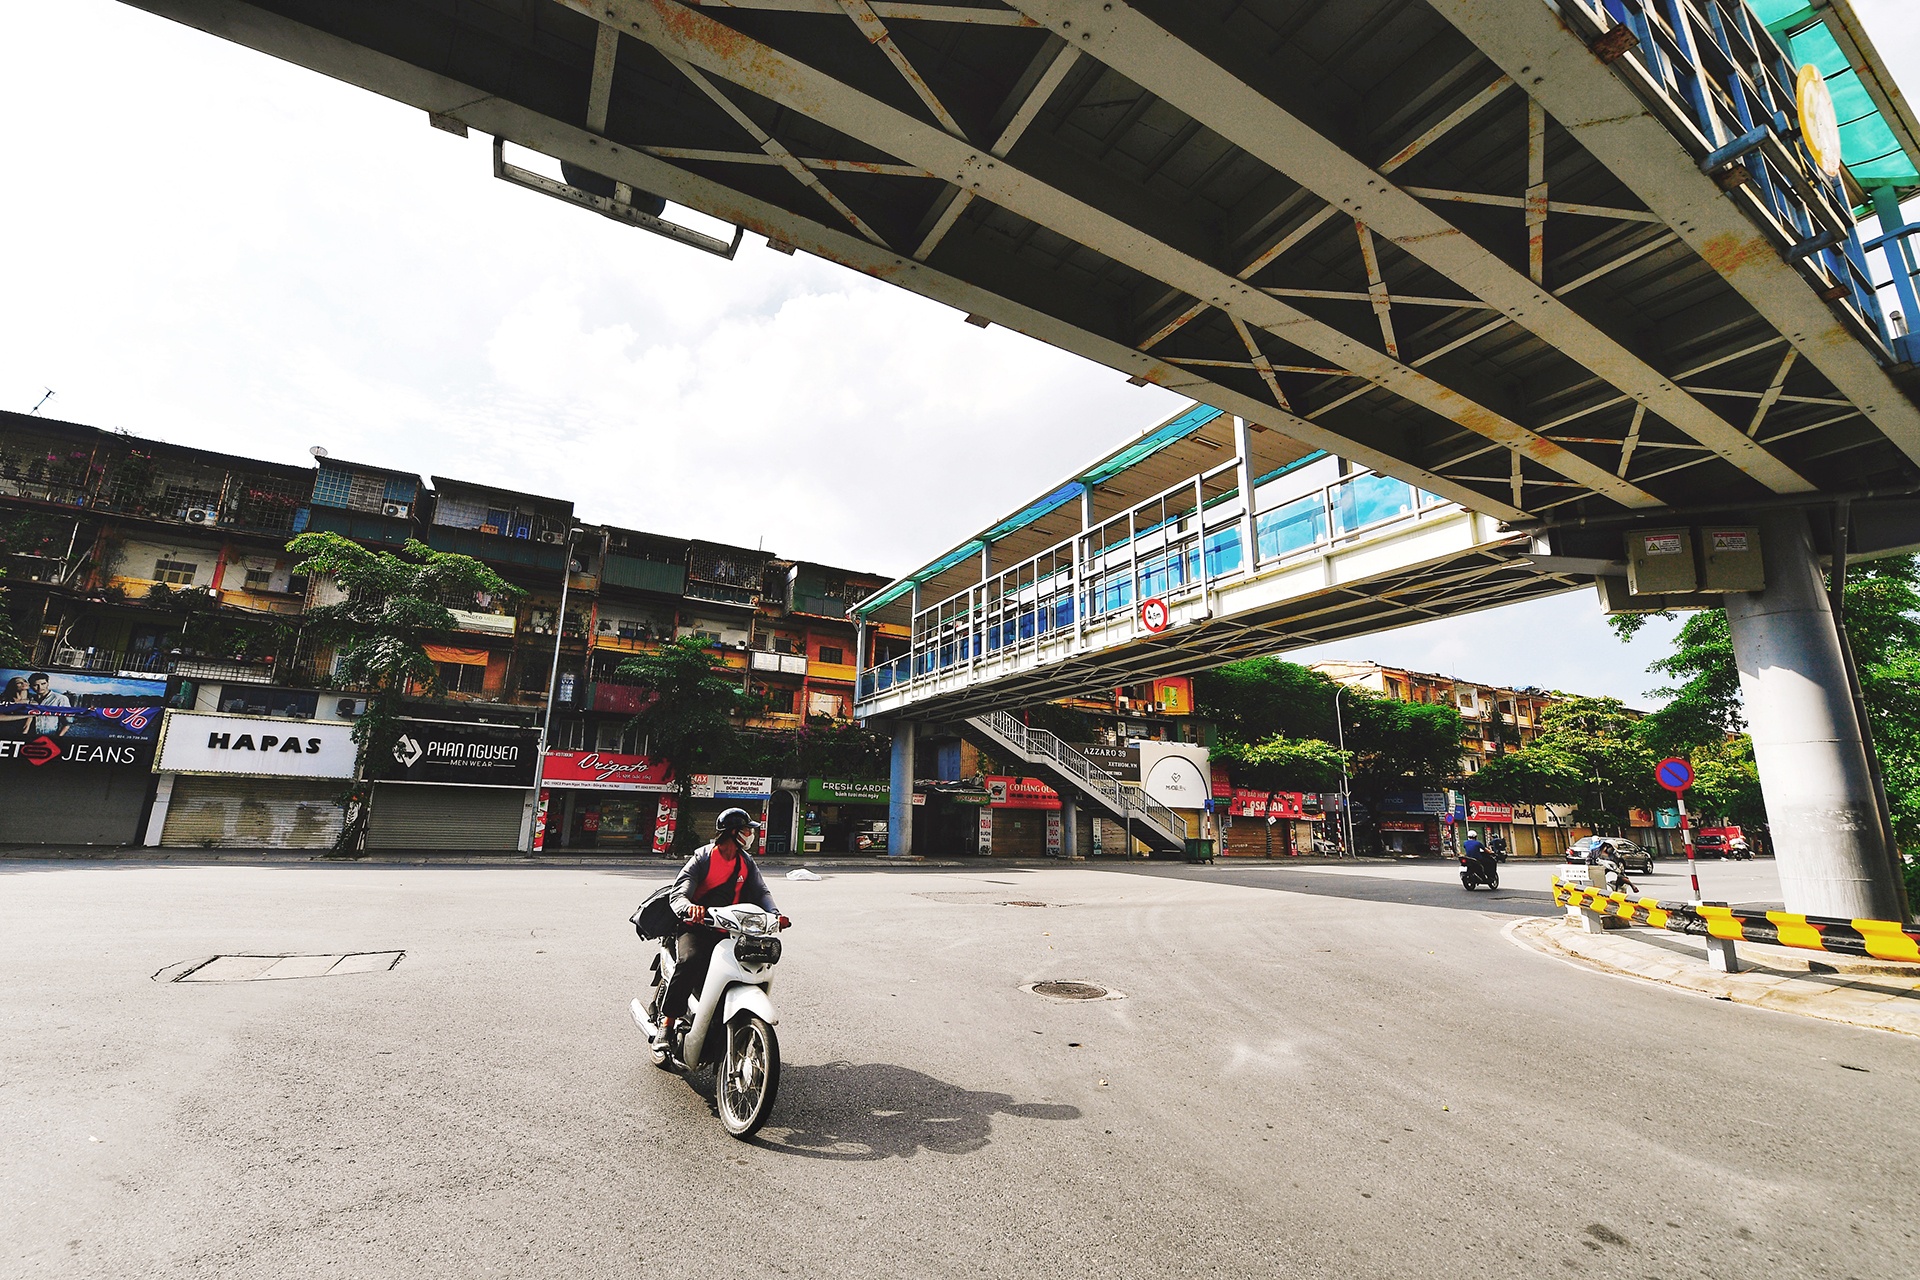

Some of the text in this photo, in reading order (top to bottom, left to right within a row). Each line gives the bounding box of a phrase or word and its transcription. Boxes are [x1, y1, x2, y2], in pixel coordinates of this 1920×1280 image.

[208, 732, 321, 754] HAPAS
[427, 741, 519, 760] PHAN NGUYEN
[1083, 747, 1127, 758] AZZARO 39
[61, 744, 136, 764] JEANS
[450, 759, 468, 767] MEN
[578, 753, 648, 781] Origato
[822, 782, 853, 791] FRESH
